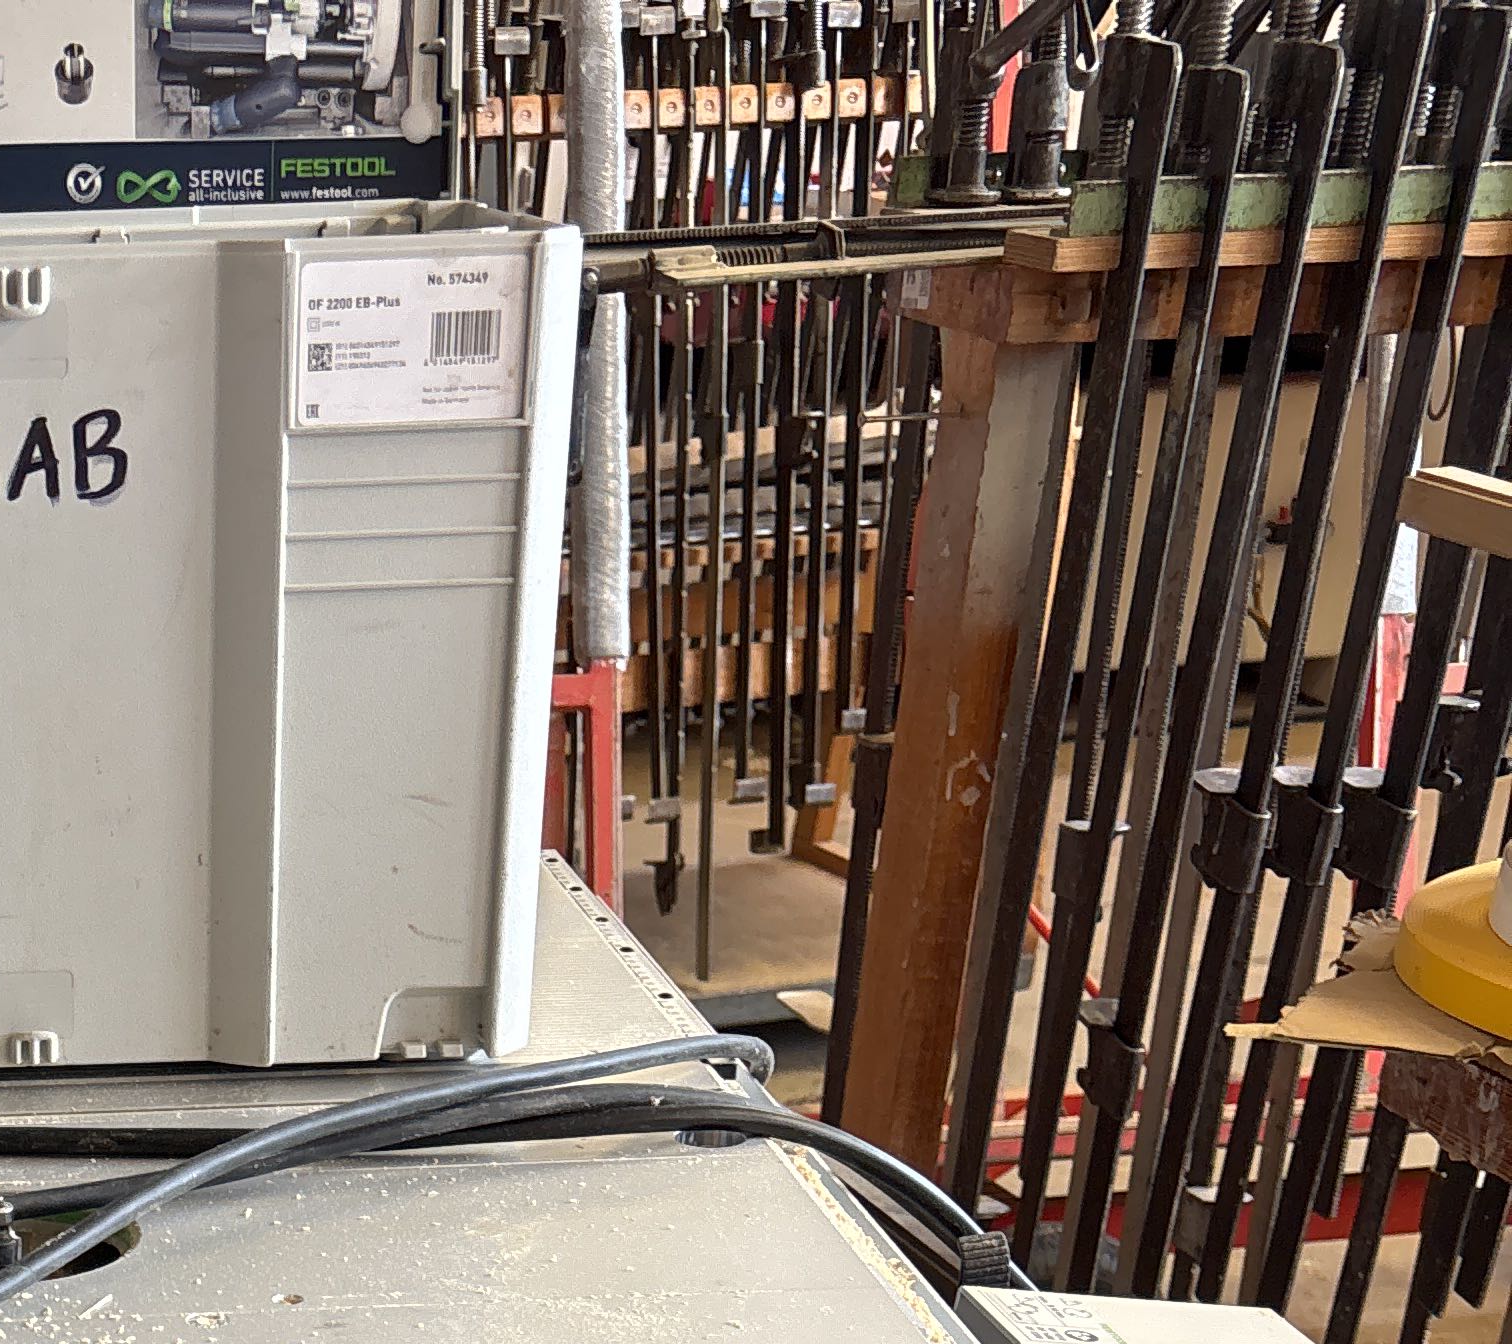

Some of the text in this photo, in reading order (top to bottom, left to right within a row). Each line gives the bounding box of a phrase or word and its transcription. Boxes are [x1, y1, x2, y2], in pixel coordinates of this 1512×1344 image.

[280, 156, 396, 179] FESTOOL
[188, 168, 265, 188] SERVICE
[188, 187, 264, 201] all-inclusive
[280, 186, 380, 199] www.festool.com
[428, 273, 446, 286] No.
[308, 295, 400, 311] OF 2200 EB-Plus
